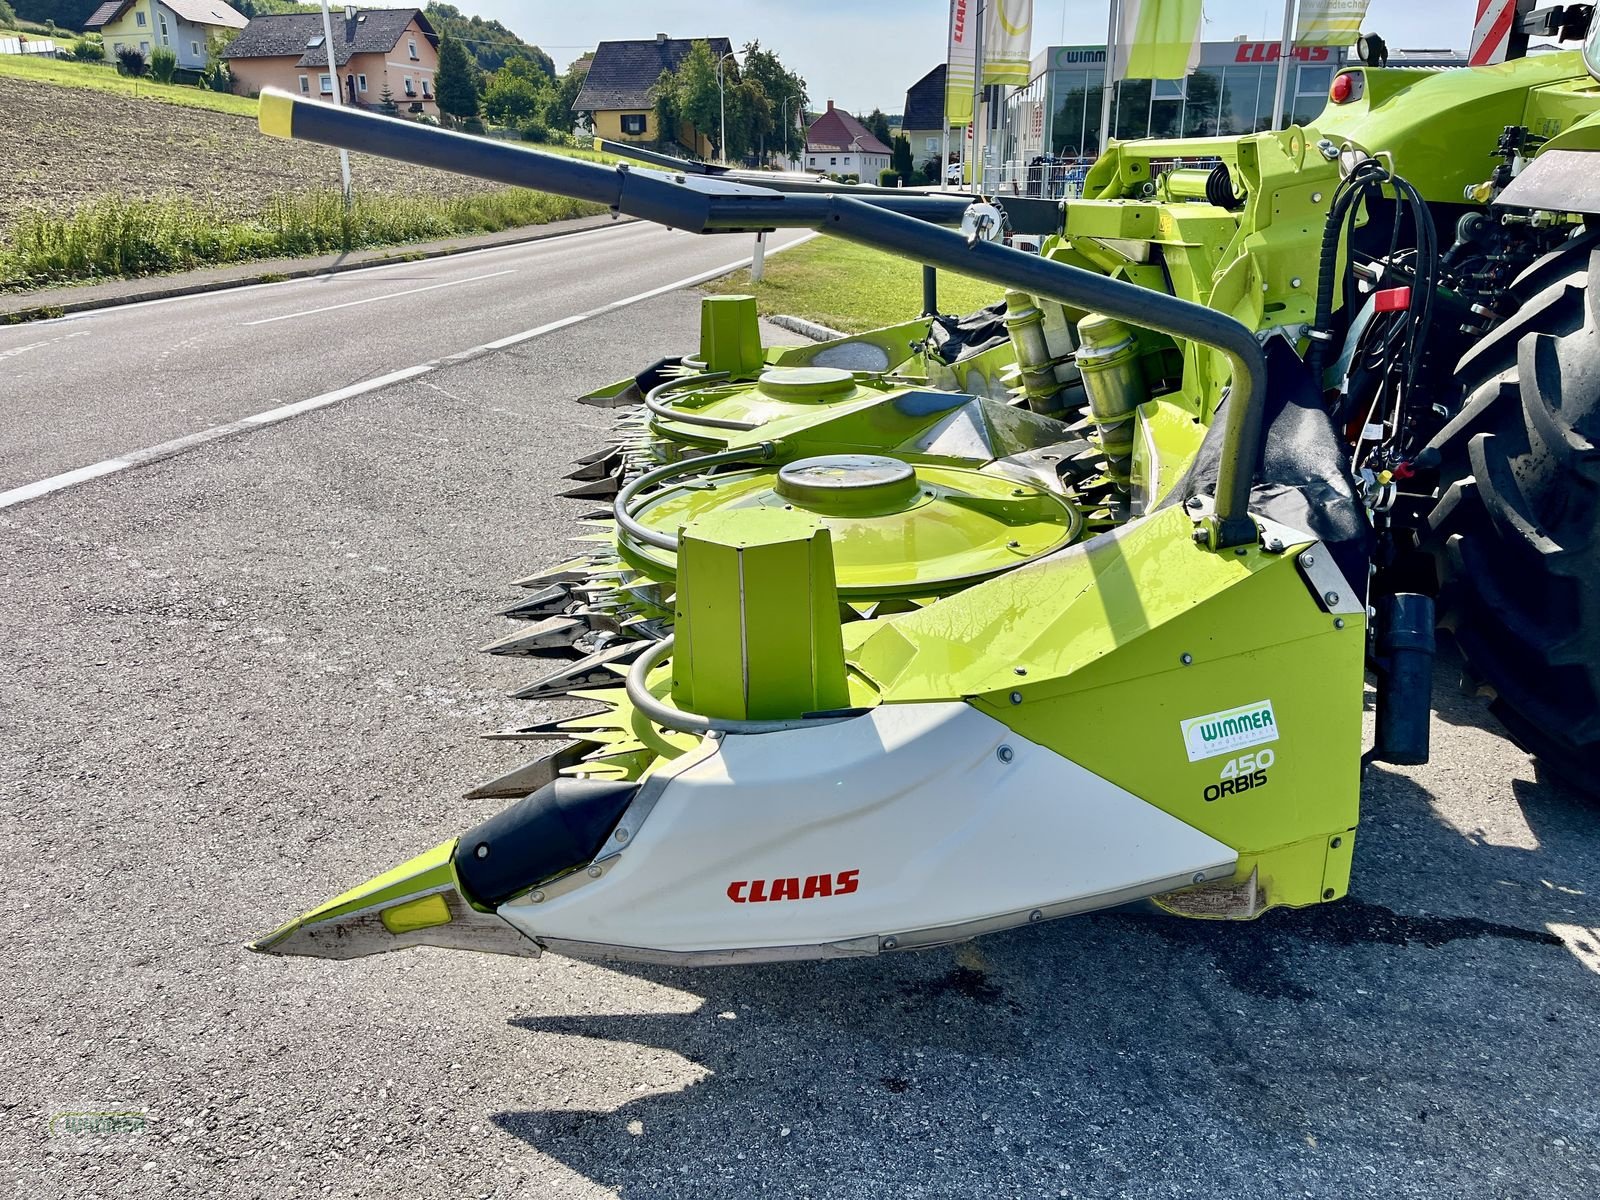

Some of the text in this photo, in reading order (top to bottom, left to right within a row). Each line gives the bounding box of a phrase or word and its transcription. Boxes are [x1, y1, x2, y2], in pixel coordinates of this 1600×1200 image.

[1067, 51, 1106, 63] WIMM
[1234, 43, 1329, 62] CLAAS
[1200, 709, 1273, 742] WIMMER
[1220, 748, 1275, 779] 450
[1203, 768, 1268, 802] ORBIS
[726, 869, 860, 904] CLAAS
